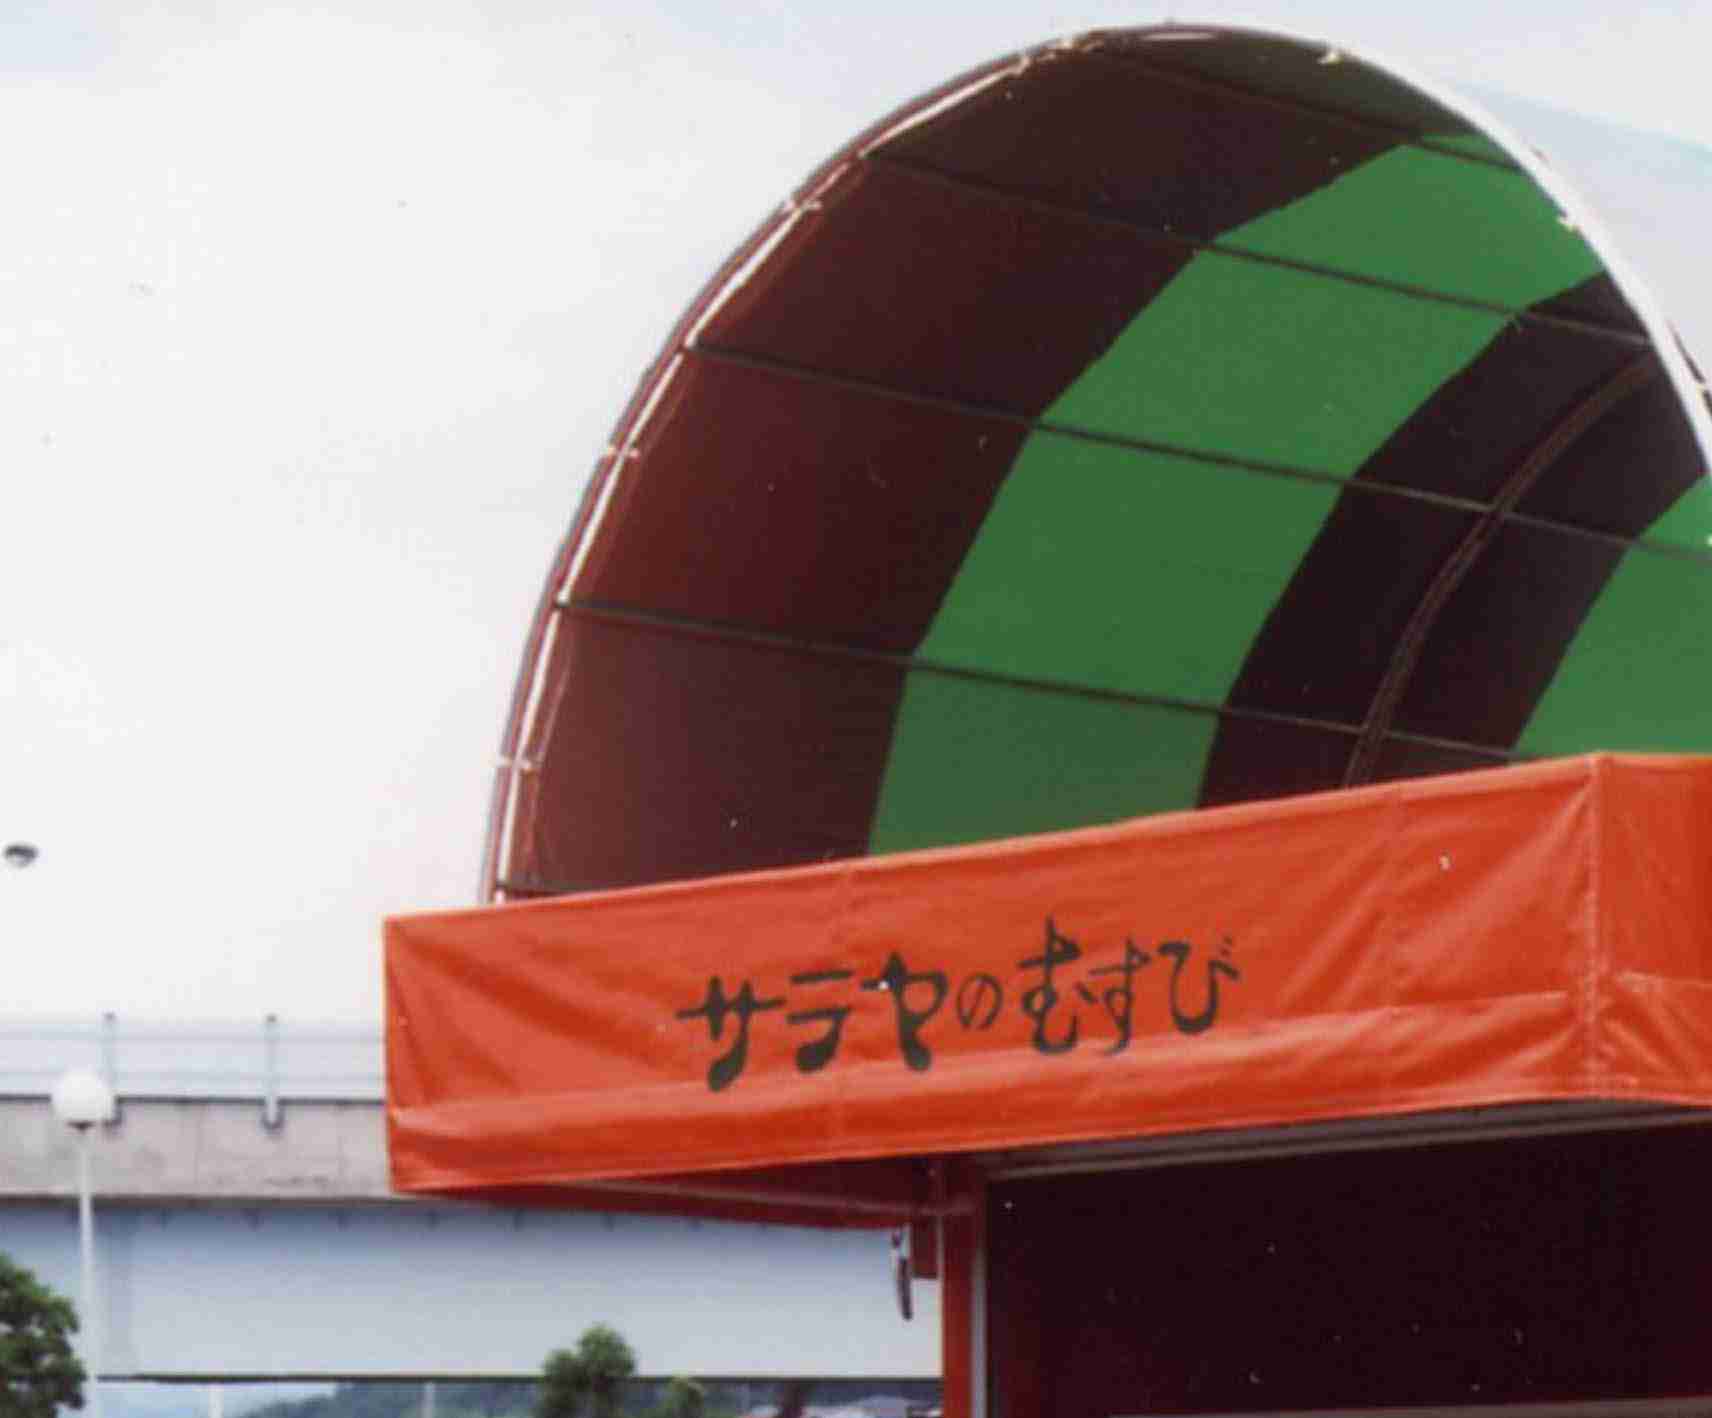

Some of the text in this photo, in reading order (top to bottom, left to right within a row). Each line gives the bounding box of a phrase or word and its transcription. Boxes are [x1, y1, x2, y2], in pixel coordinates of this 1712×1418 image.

[674, 917, 1241, 1092] サラヤのむすび
